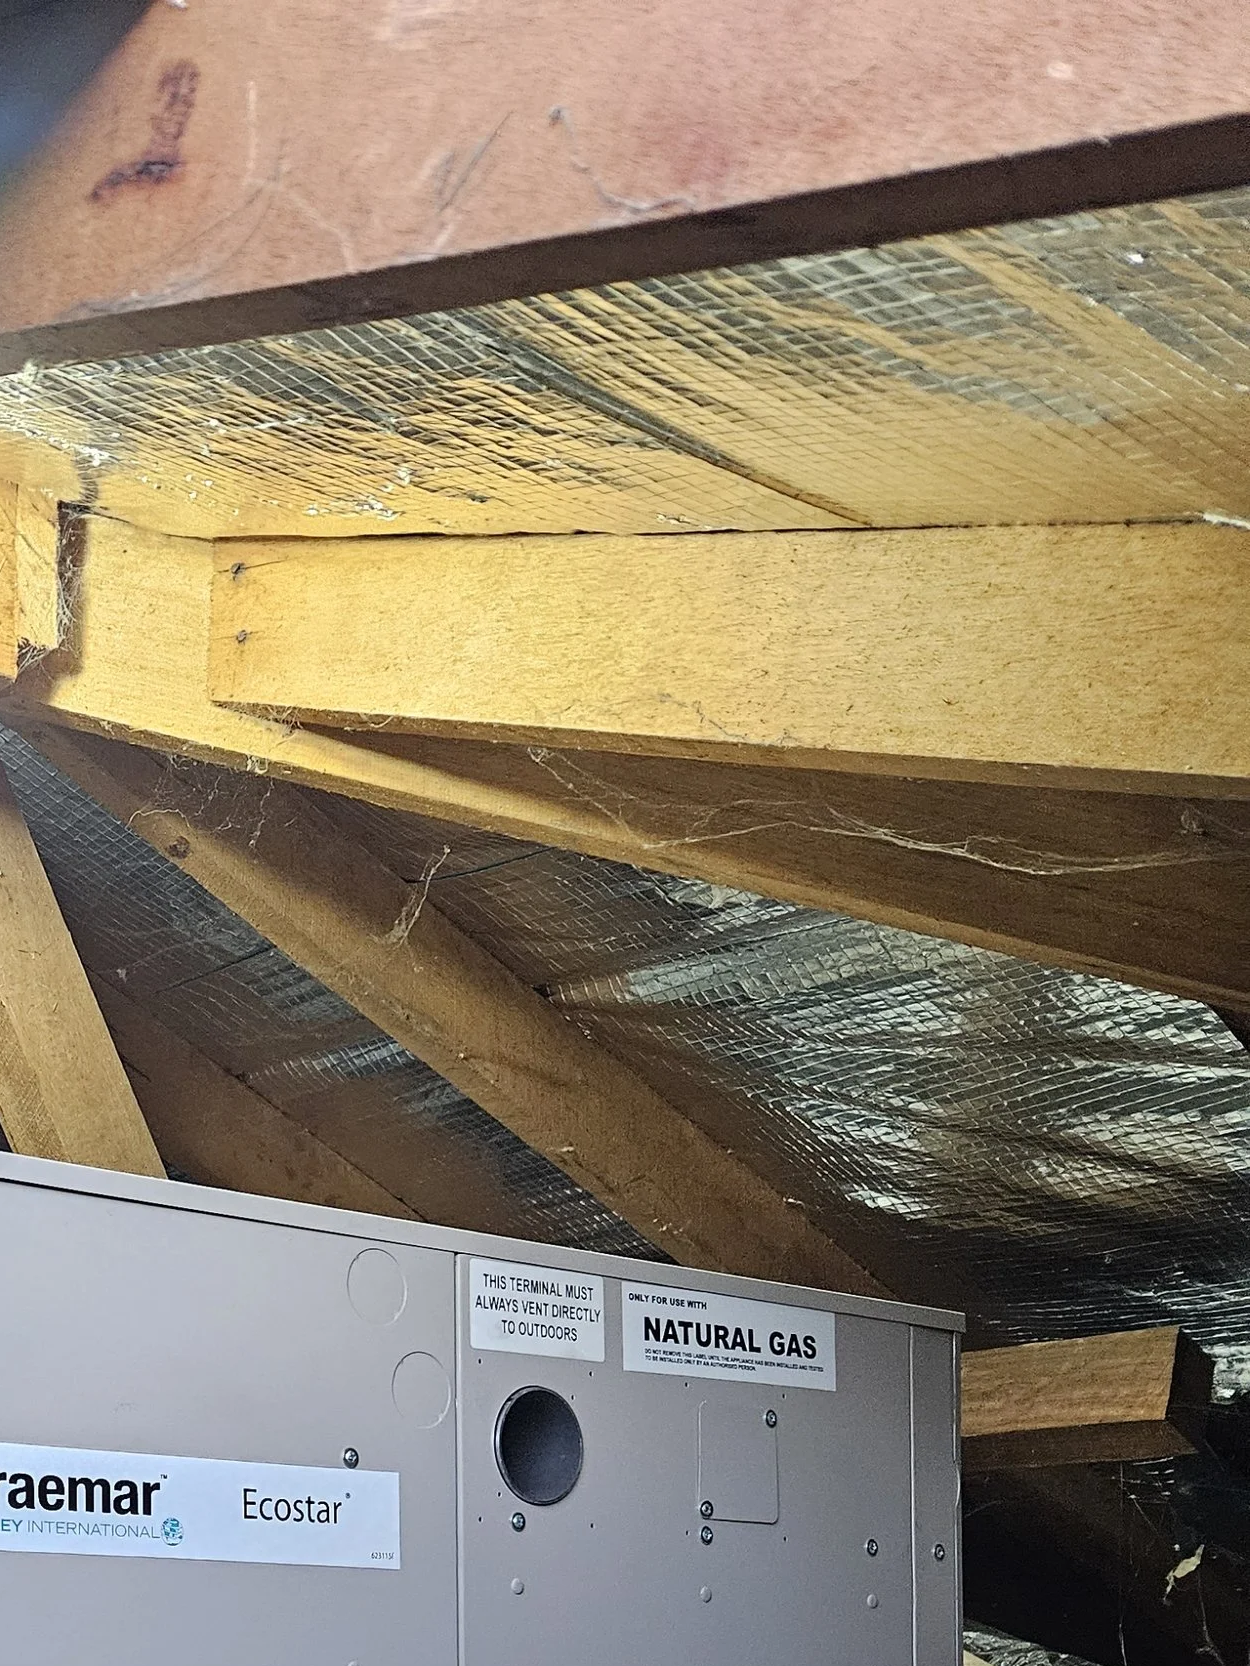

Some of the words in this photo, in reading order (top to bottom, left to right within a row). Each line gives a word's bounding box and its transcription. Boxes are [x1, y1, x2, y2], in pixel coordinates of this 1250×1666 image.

[483, 1273, 507, 1290] THIS
[510, 1277, 563, 1297] TERMINAL
[565, 1284, 594, 1301] MUST
[628, 1292, 650, 1303] ONLY
[651, 1295, 668, 1306] FOR
[669, 1297, 686, 1308] USE
[686, 1299, 707, 1310] WITH
[475, 1295, 519, 1313] ALWAYS
[521, 1300, 550, 1317] VENT
[551, 1304, 602, 1323] DIRECTLY
[501, 1319, 516, 1335] TO
[518, 1321, 578, 1342] OUTDOORS
[643, 1316, 761, 1353] NATURAL
[769, 1331, 817, 1359] GAS
[243, 1488, 342, 1524] Ecostar
[27, 1520, 161, 1539] INTERNATIONAL
